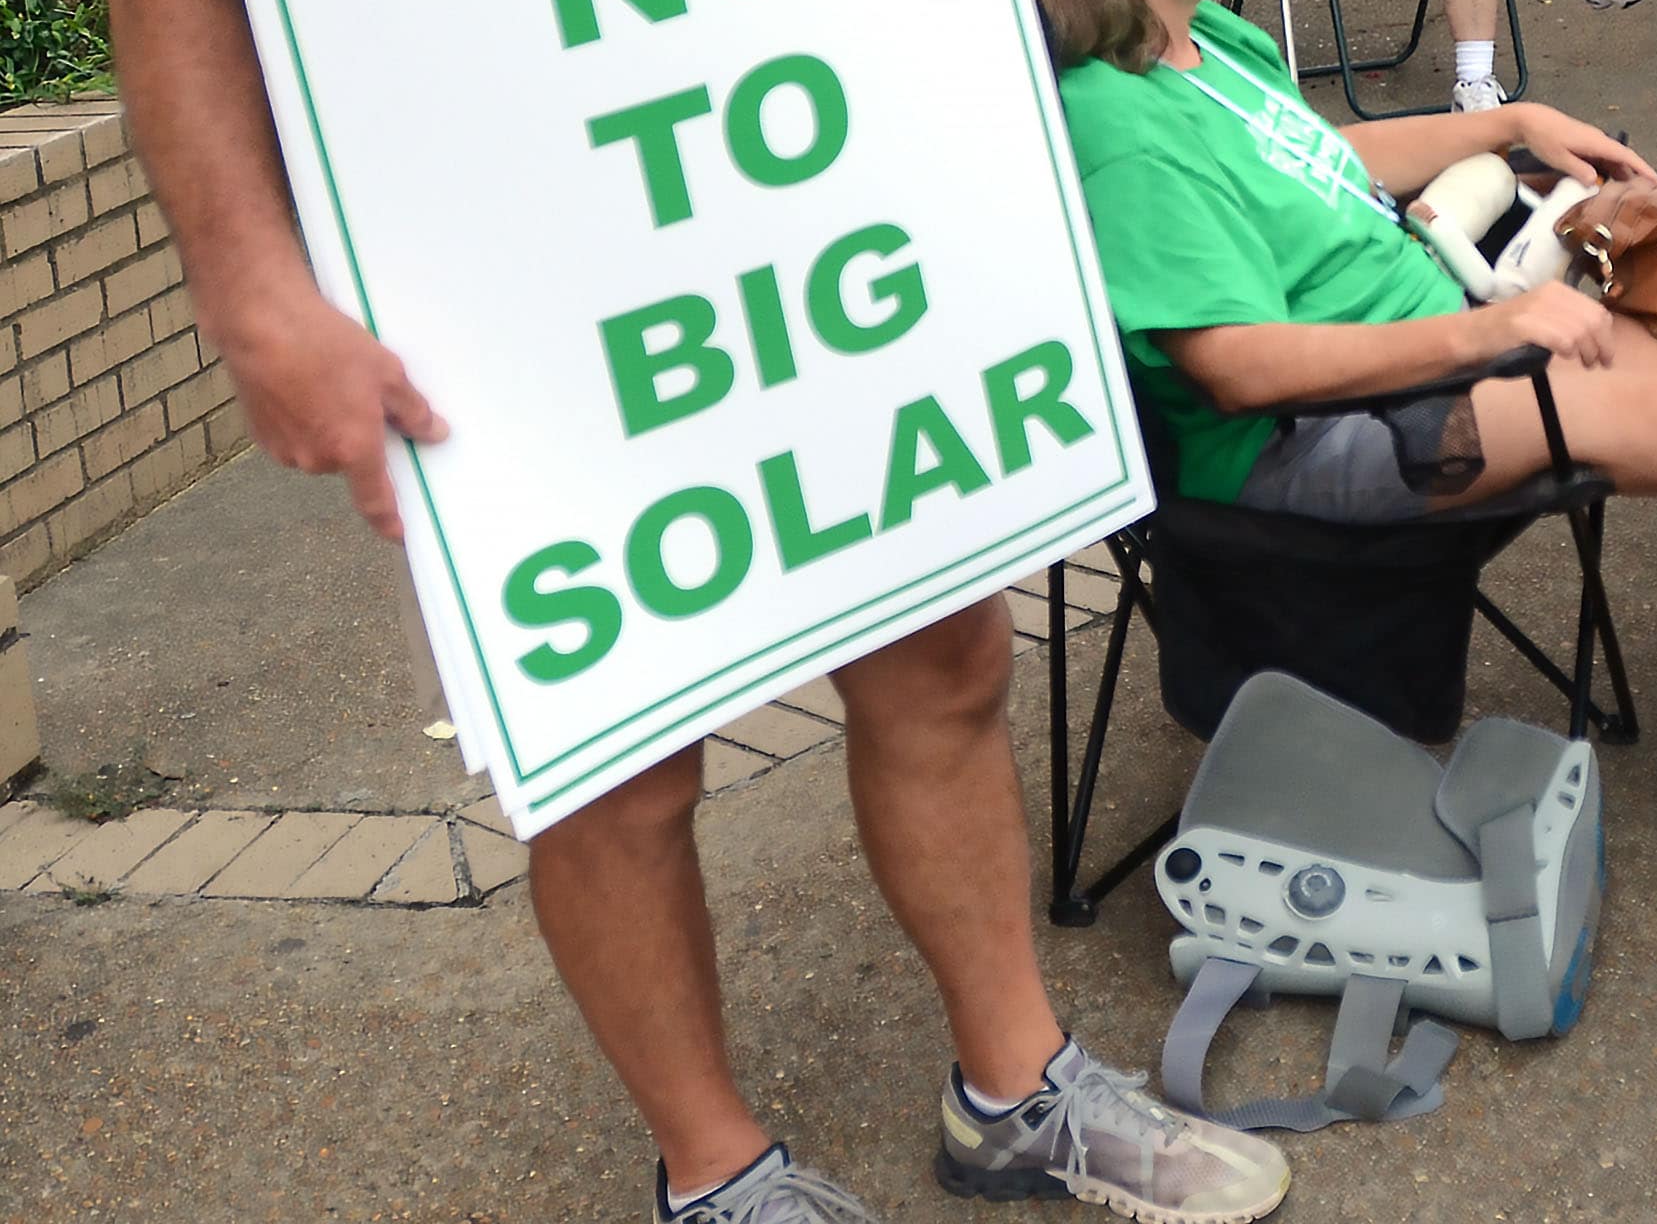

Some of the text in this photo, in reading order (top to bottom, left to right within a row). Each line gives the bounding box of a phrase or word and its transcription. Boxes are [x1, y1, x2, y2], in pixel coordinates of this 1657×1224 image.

[587, 53, 850, 229] TO
[599, 222, 930, 438] BIG
[501, 338, 1095, 685] SOLAR
